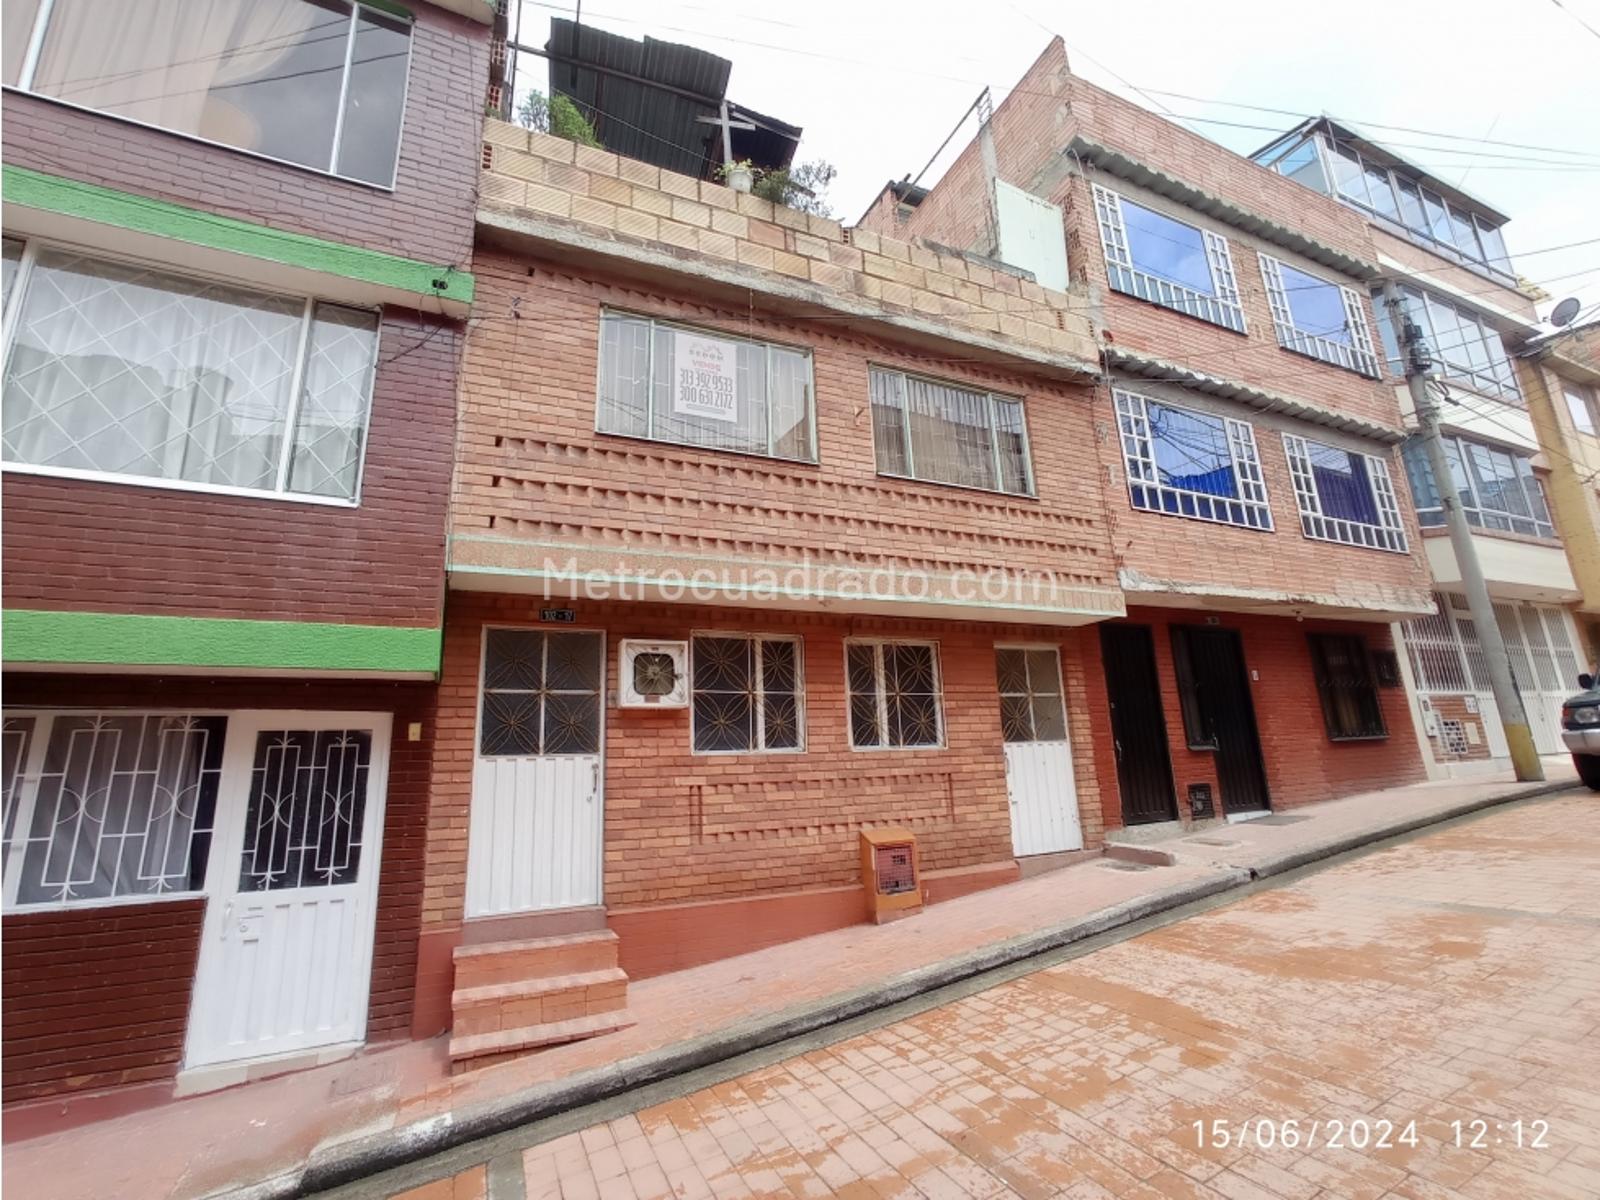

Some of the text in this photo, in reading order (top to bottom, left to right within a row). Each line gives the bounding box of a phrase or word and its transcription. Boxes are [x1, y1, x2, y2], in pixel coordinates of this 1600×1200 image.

[680, 368, 694, 387] 313
[712, 375, 733, 393] 9533
[680, 386, 697, 402] 300
